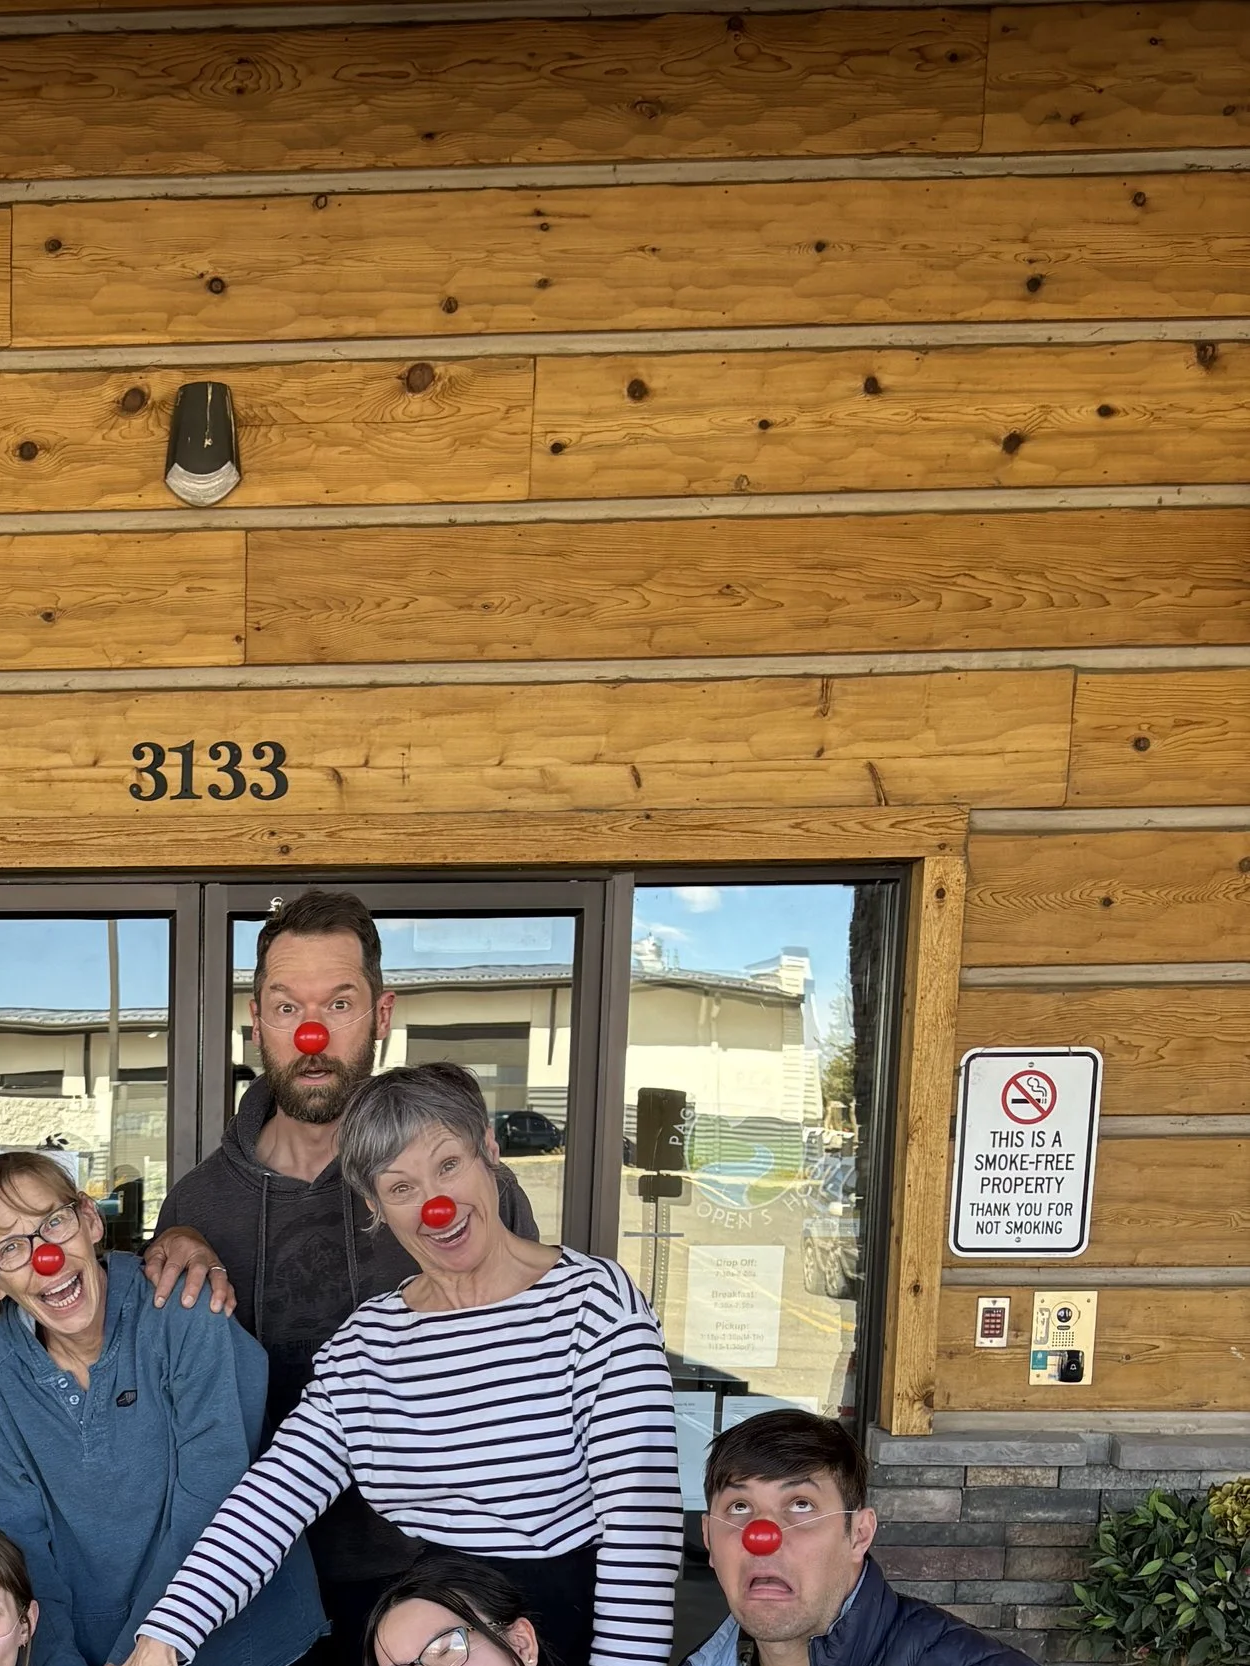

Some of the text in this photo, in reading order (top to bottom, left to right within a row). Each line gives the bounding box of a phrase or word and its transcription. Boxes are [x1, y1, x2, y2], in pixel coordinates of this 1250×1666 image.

[129, 739, 289, 801] 3133
[990, 1130, 1063, 1149] THIS IS A
[974, 1153, 1076, 1172] SMOKE-FREE
[980, 1176, 1065, 1195] PROPERTY
[696, 1202, 752, 1230] OPEN
[969, 1202, 1074, 1217] THANK YOU FOR
[975, 1220, 1064, 1235] NOT SMOKING
[716, 1258, 738, 1269] Drop
